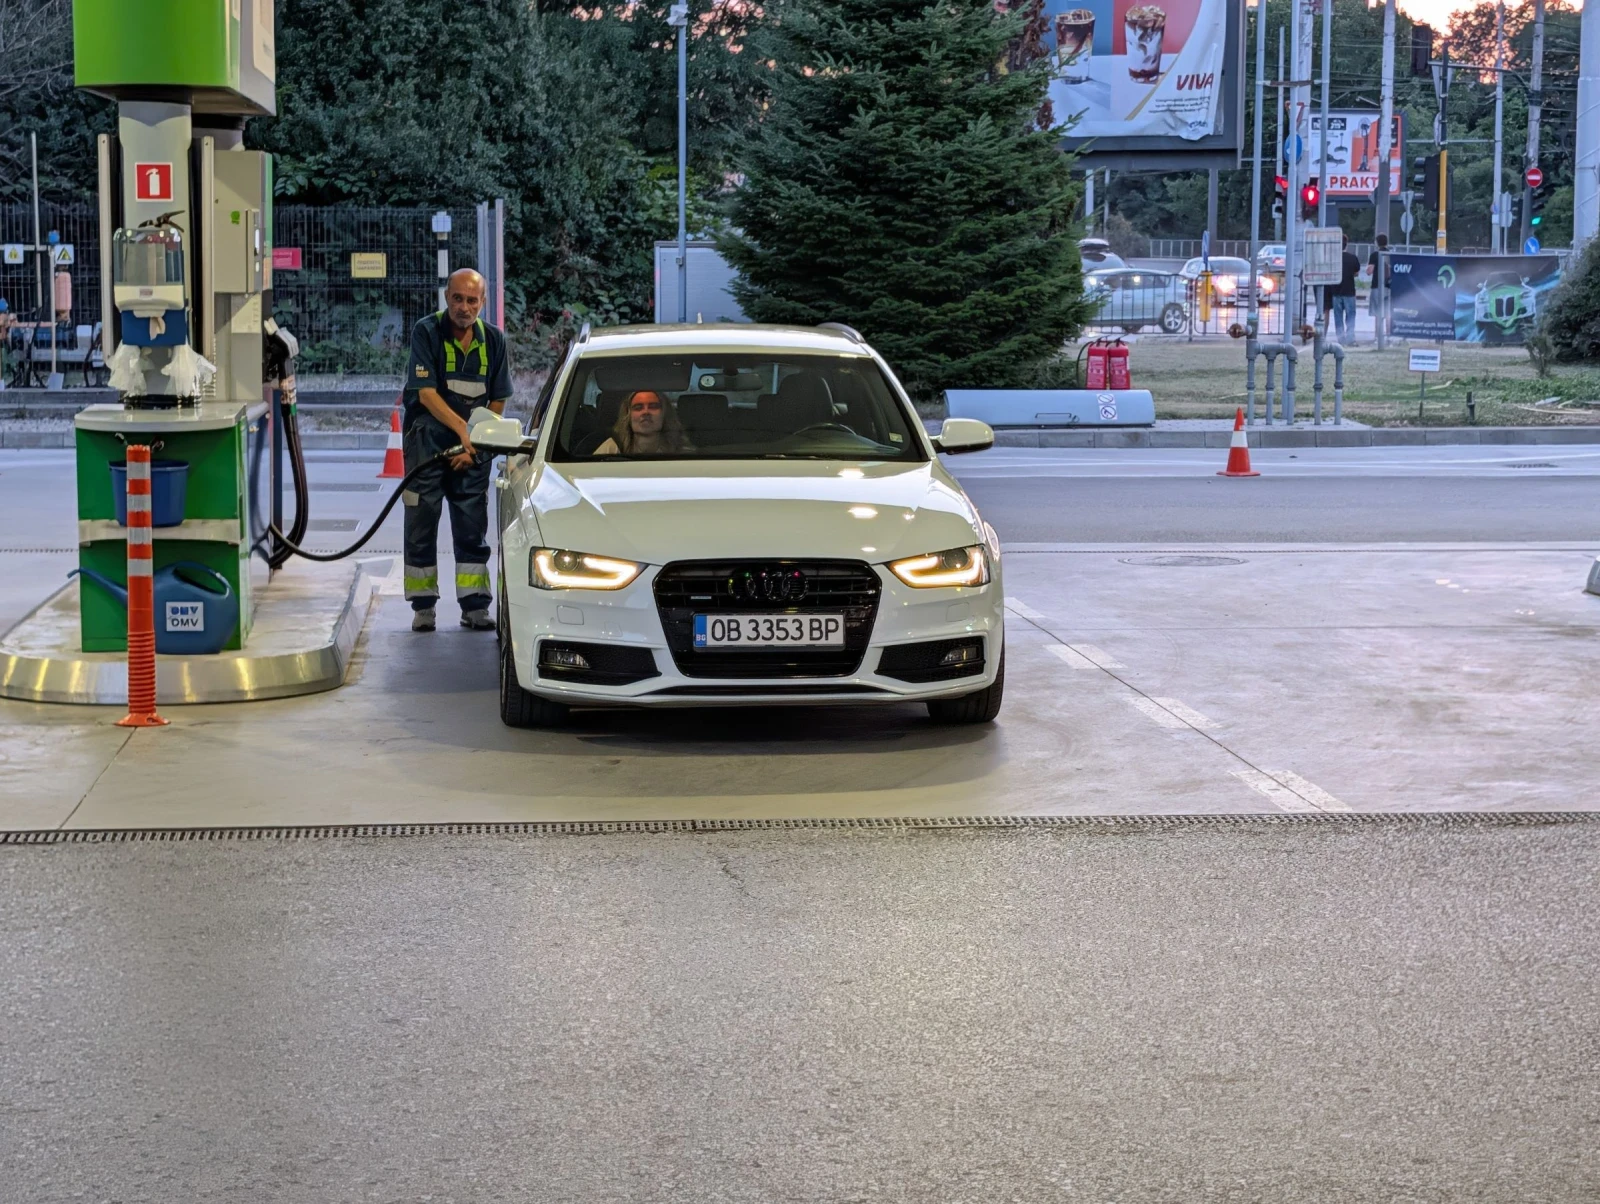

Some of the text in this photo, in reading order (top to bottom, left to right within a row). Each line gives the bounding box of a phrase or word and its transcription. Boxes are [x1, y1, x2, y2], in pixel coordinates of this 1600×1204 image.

[1176, 73, 1214, 90] VIVA
[1329, 175, 1391, 189] PRAKT
[1393, 264, 1412, 274] OMV
[171, 618, 198, 627] OMV
[746, 618, 804, 642] 3353
[809, 618, 840, 641] BP
[695, 633, 707, 642] BG
